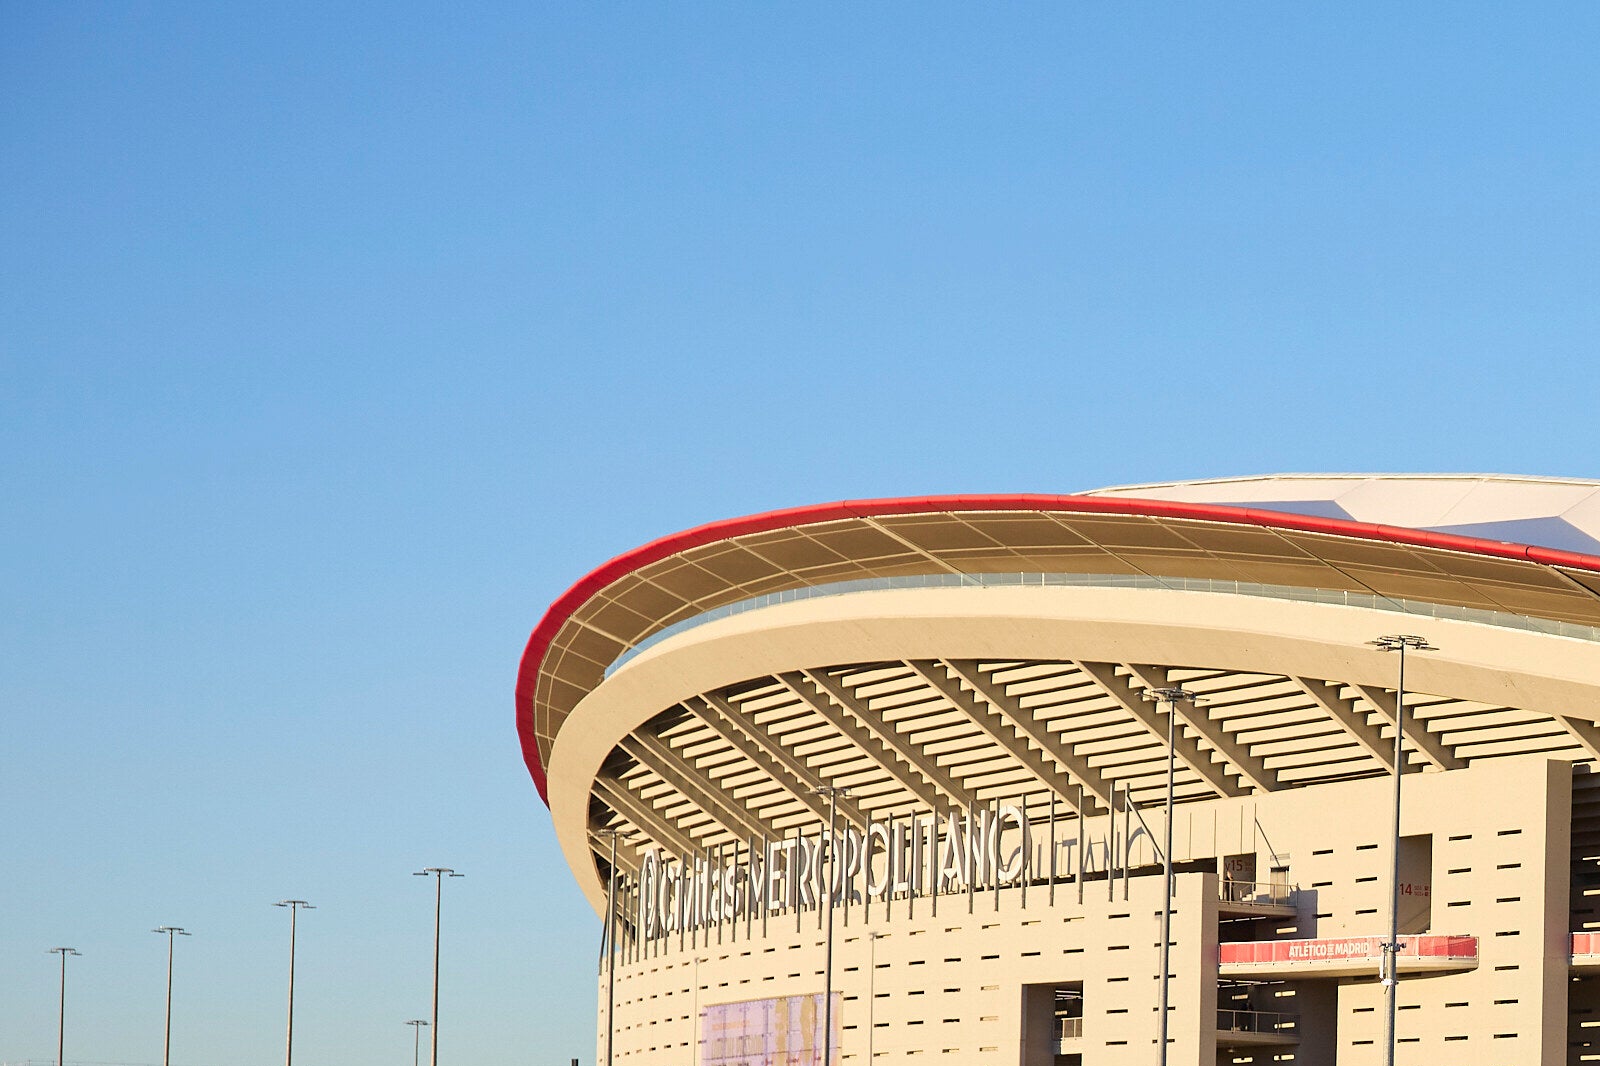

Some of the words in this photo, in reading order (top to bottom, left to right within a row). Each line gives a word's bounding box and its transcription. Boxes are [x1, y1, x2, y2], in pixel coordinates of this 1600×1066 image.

[748, 806, 1031, 911] METROPOLITANO
[1289, 942, 1327, 957] ATLÉTICO
[1335, 943, 1369, 954] MADRID
